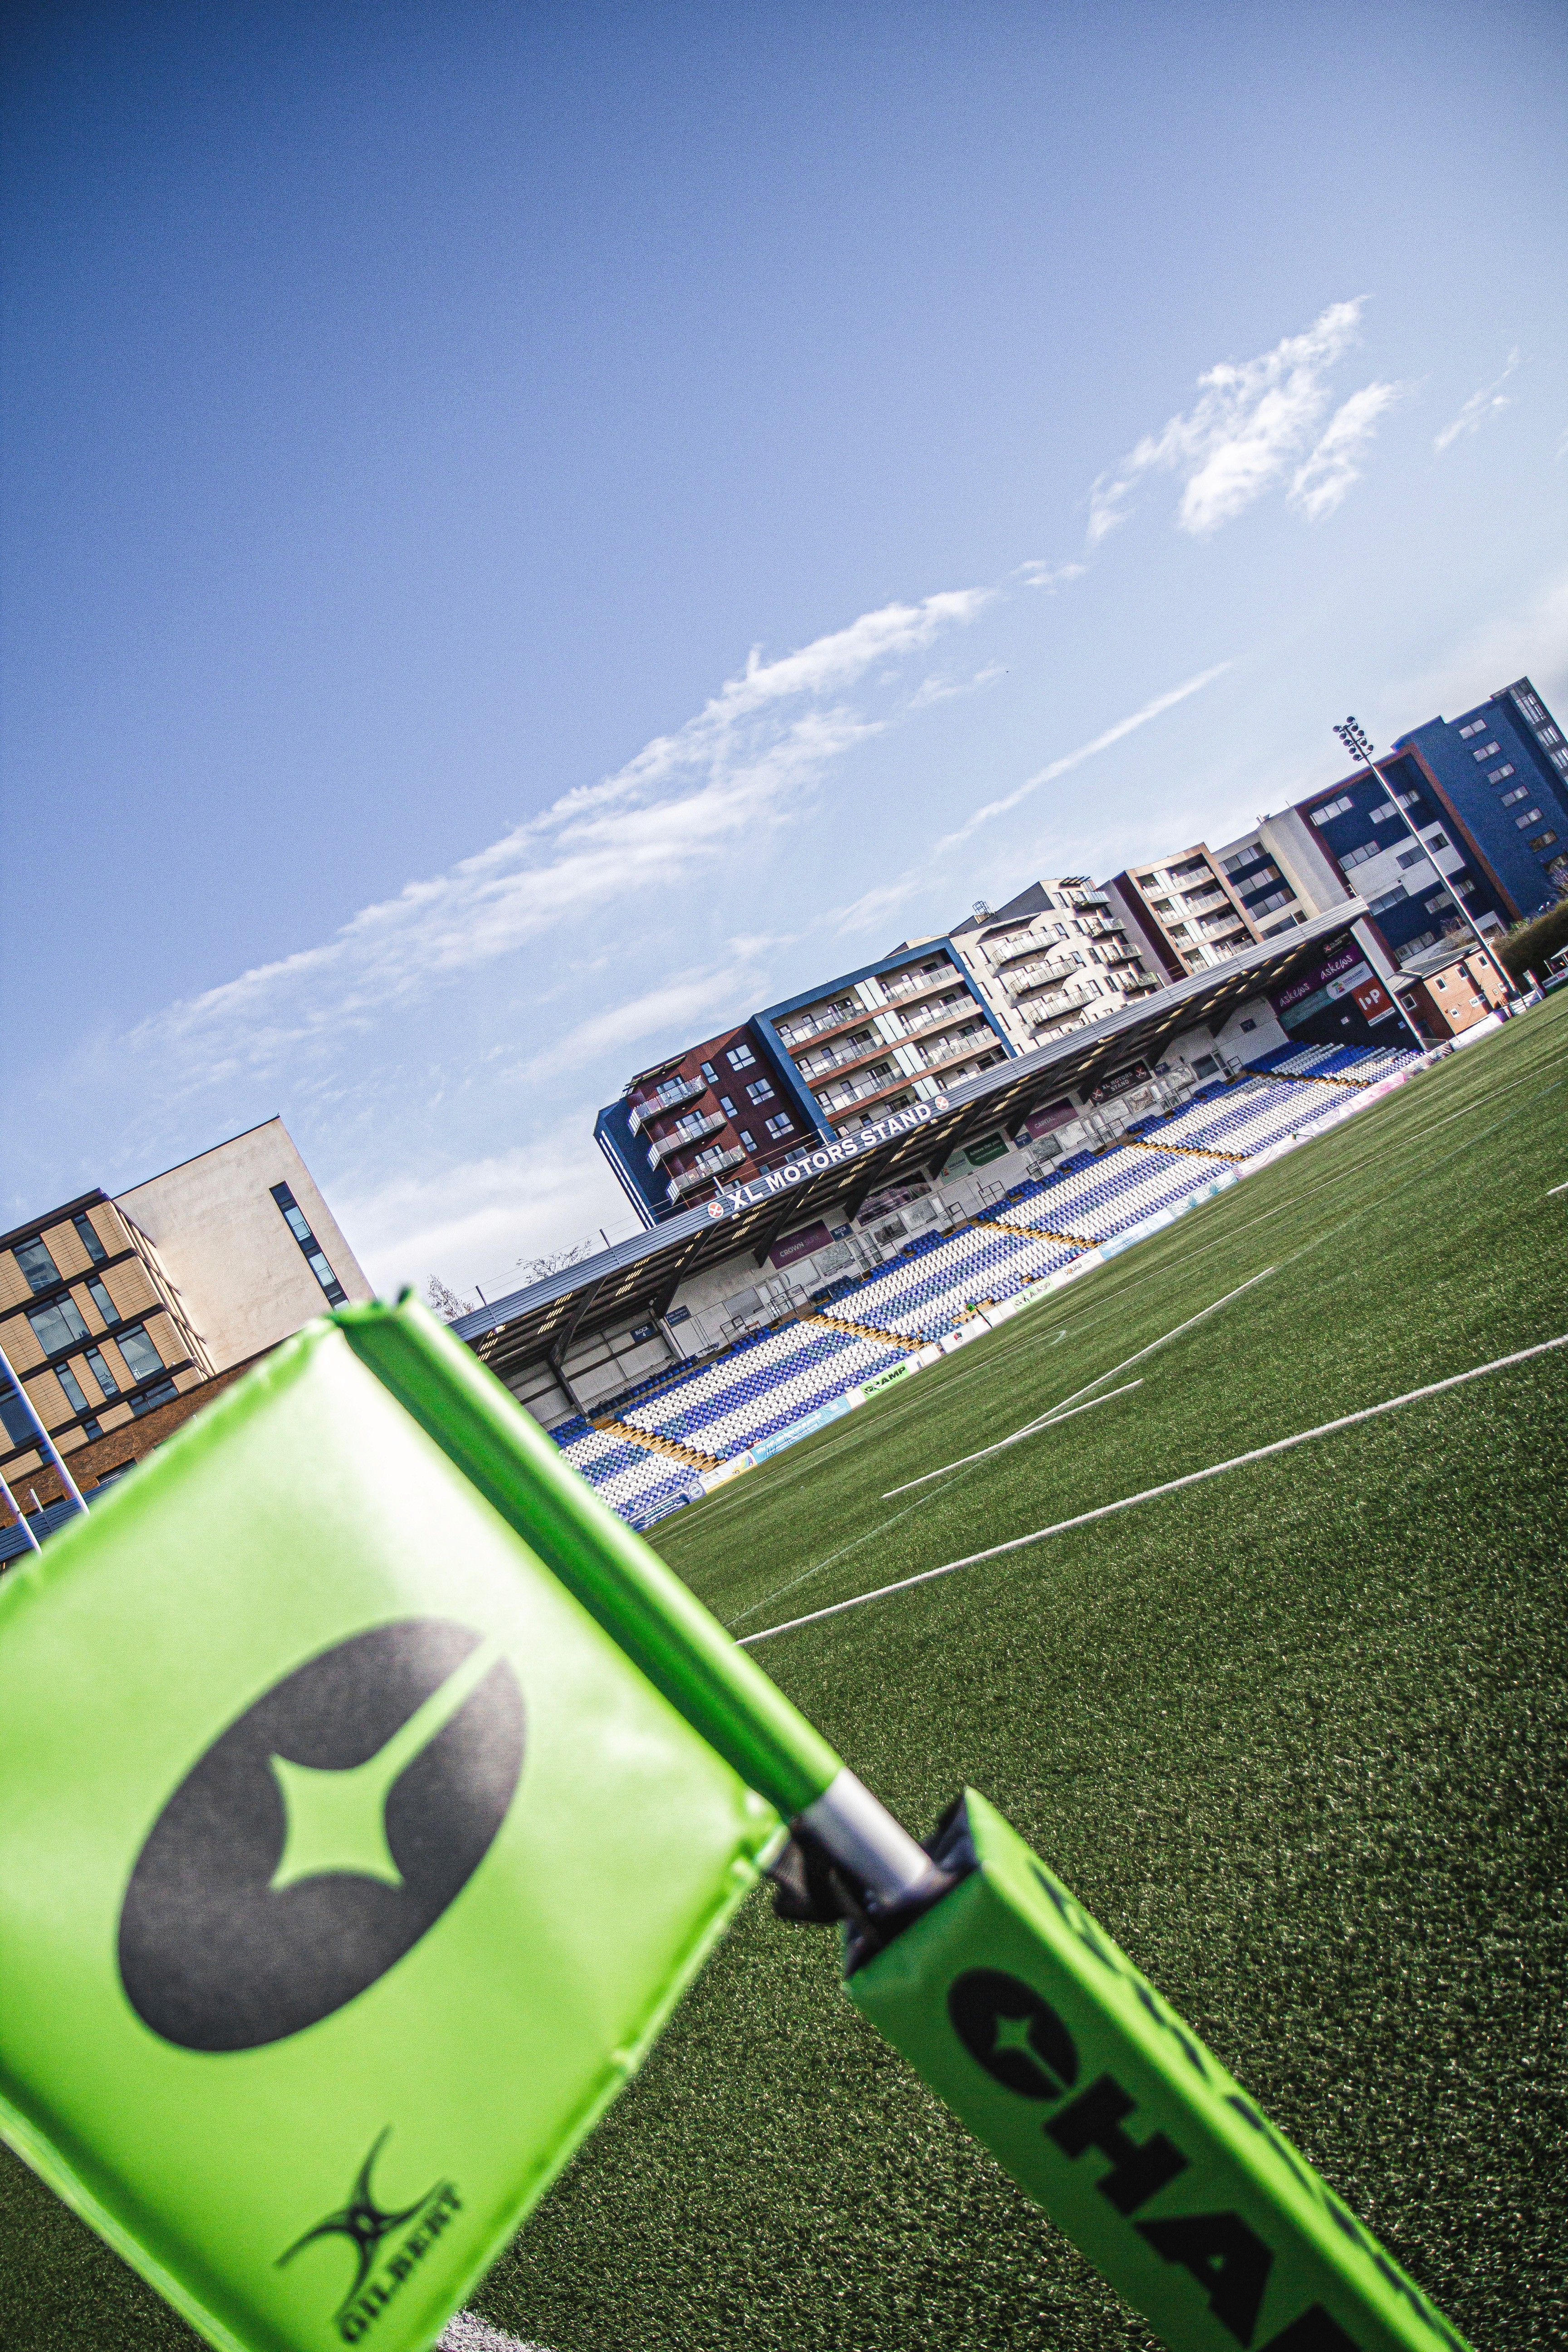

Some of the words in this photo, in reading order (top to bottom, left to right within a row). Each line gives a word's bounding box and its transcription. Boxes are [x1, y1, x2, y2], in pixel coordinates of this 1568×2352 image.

[1317, 951, 1354, 980] askews
[1276, 980, 1312, 1007] askews
[1110, 1071, 1133, 1085] MOTORS
[1110, 1078, 1130, 1092] STAND
[727, 1186, 764, 1210] XL
[765, 1137, 858, 1193] MOTORS
[860, 1103, 931, 1147] STAND
[1192, 1185, 1211, 1201] clear
[833, 1225, 847, 1235] BLOCK
[779, 1241, 805, 1258] CROWN
[1063, 1262, 1083, 1276] SQUAB
[634, 1325, 649, 1335] BLOCK
[338, 2180, 462, 2344] GILBERT
